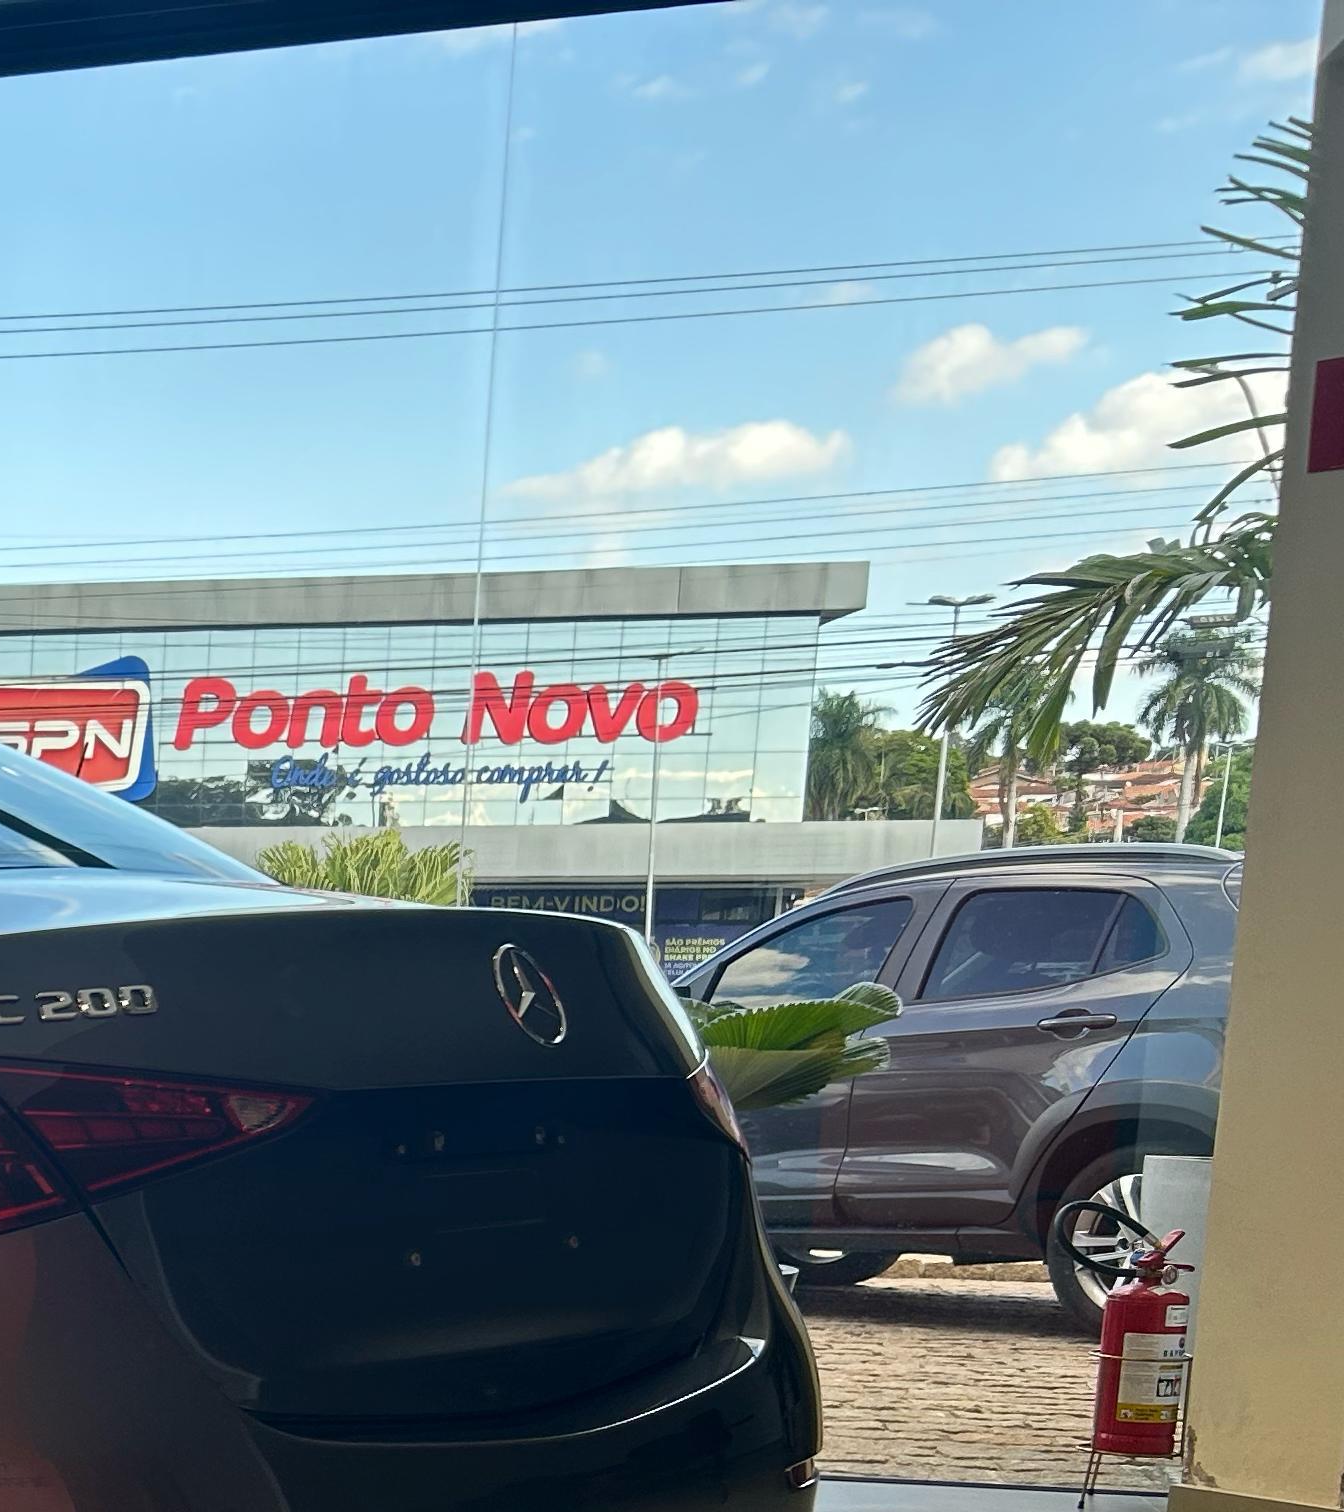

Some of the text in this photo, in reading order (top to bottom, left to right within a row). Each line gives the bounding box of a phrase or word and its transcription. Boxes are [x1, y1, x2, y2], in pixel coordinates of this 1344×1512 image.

[173, 670, 700, 751] Ponto Novo
[370, 751, 465, 797] gostoso
[35, 984, 160, 1021] 200
